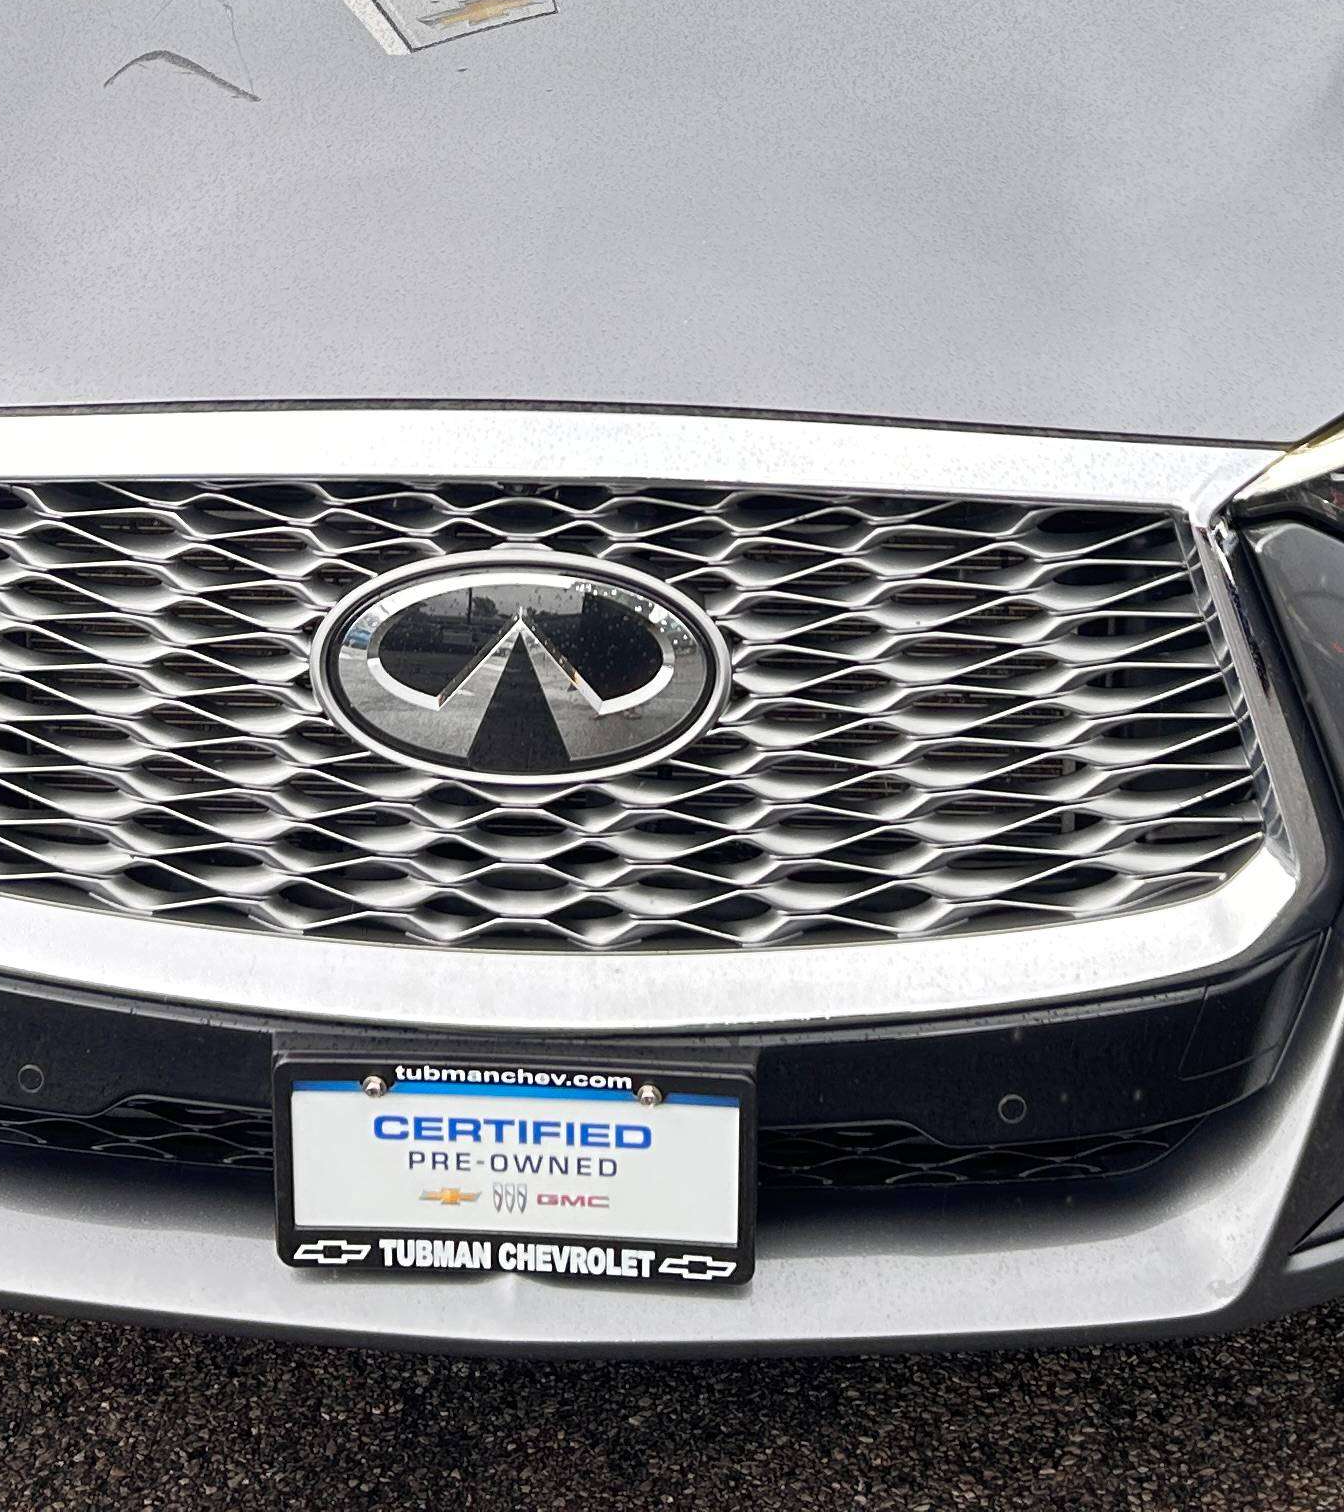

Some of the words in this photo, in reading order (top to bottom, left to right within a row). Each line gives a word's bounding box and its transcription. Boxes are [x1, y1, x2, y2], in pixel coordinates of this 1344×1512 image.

[395, 1065, 632, 1090] tubmanchev.com
[373, 1115, 652, 1149] CERTIFIED
[408, 1151, 618, 1177] PRE-OWNED
[536, 1194, 610, 1209] GMC
[379, 1239, 492, 1270] TUBMAN
[498, 1243, 656, 1278] CHEVROLET
